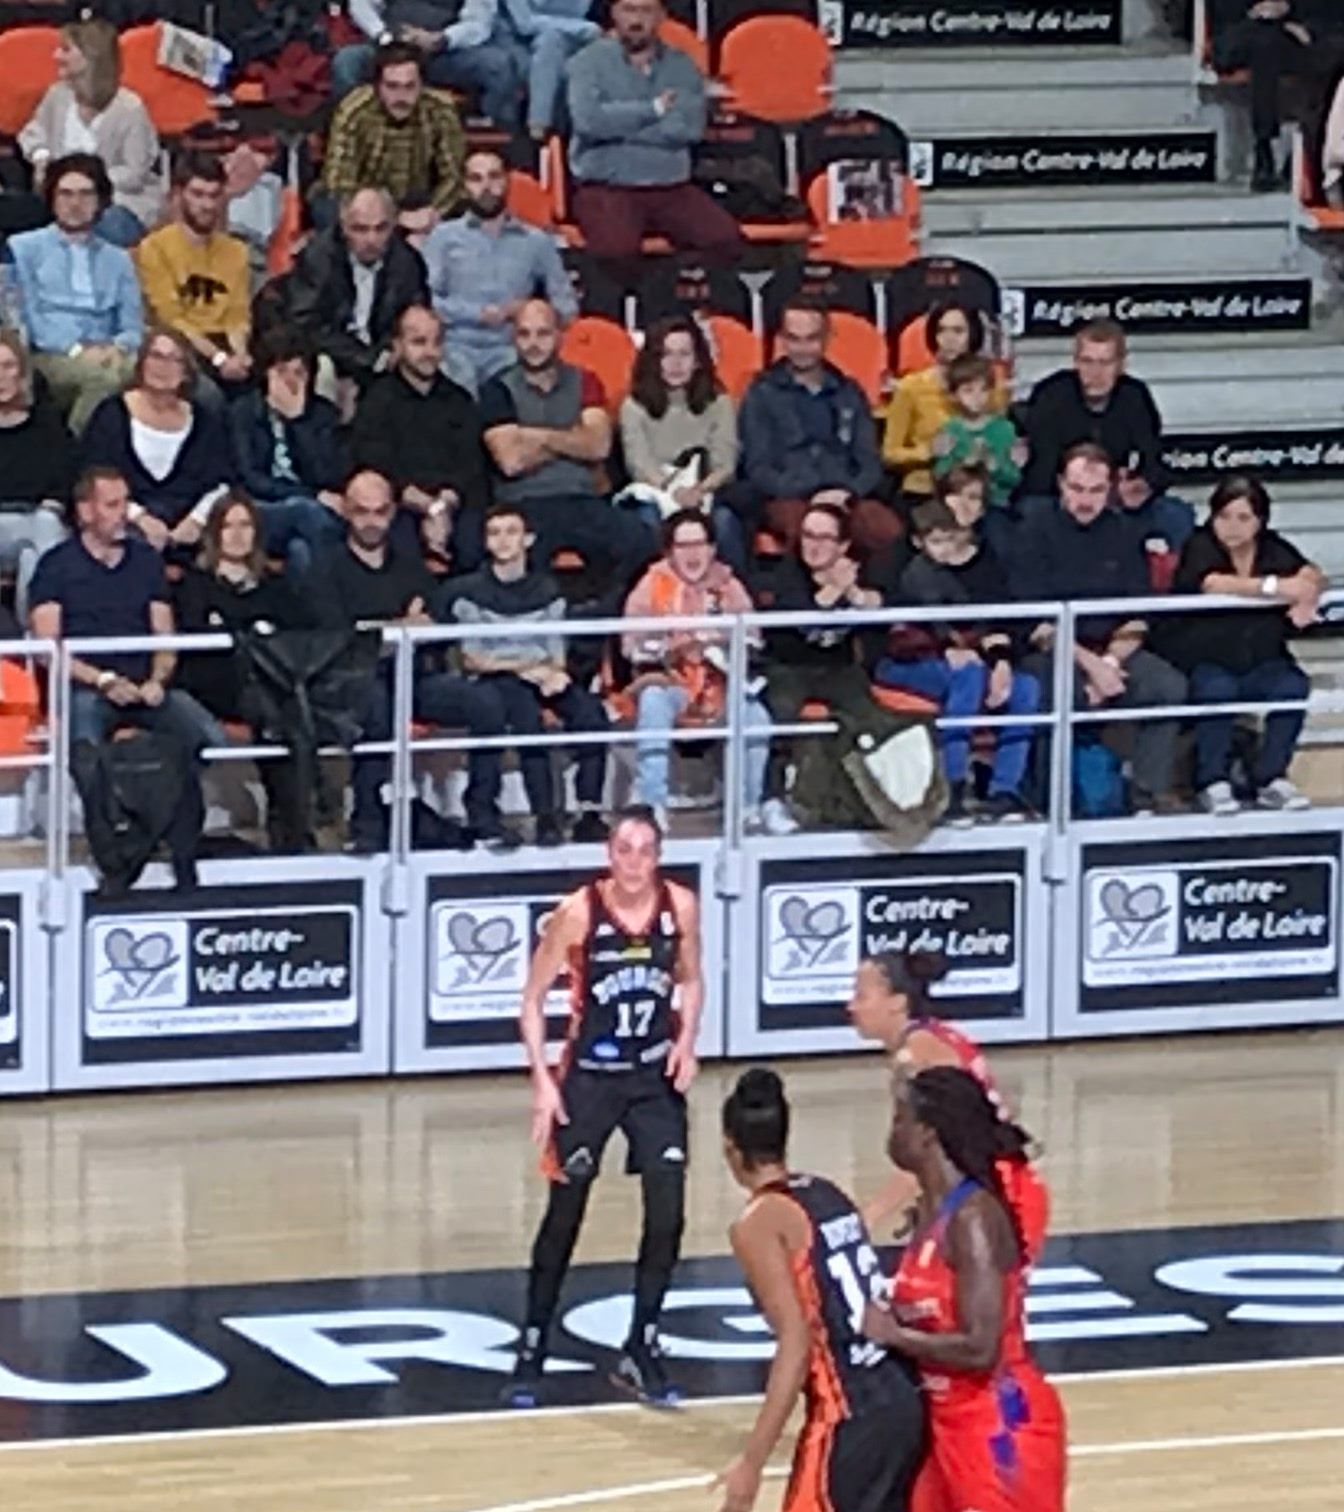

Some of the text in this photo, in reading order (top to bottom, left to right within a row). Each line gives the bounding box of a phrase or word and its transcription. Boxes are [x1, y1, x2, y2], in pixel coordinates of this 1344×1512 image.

[1131, 147, 1156, 170] de
[1157, 148, 1207, 170] Loire
[1224, 295, 1251, 318] de
[1252, 295, 1303, 318] Loire
[1183, 878, 1288, 907] Centre-
[865, 895, 971, 923] Centre-
[1184, 908, 1327, 942] Val de Loire
[193, 927, 306, 955] Centre-
[945, 927, 1011, 956] Loire
[194, 960, 348, 993] Val de Loire
[614, 999, 657, 1038] 17
